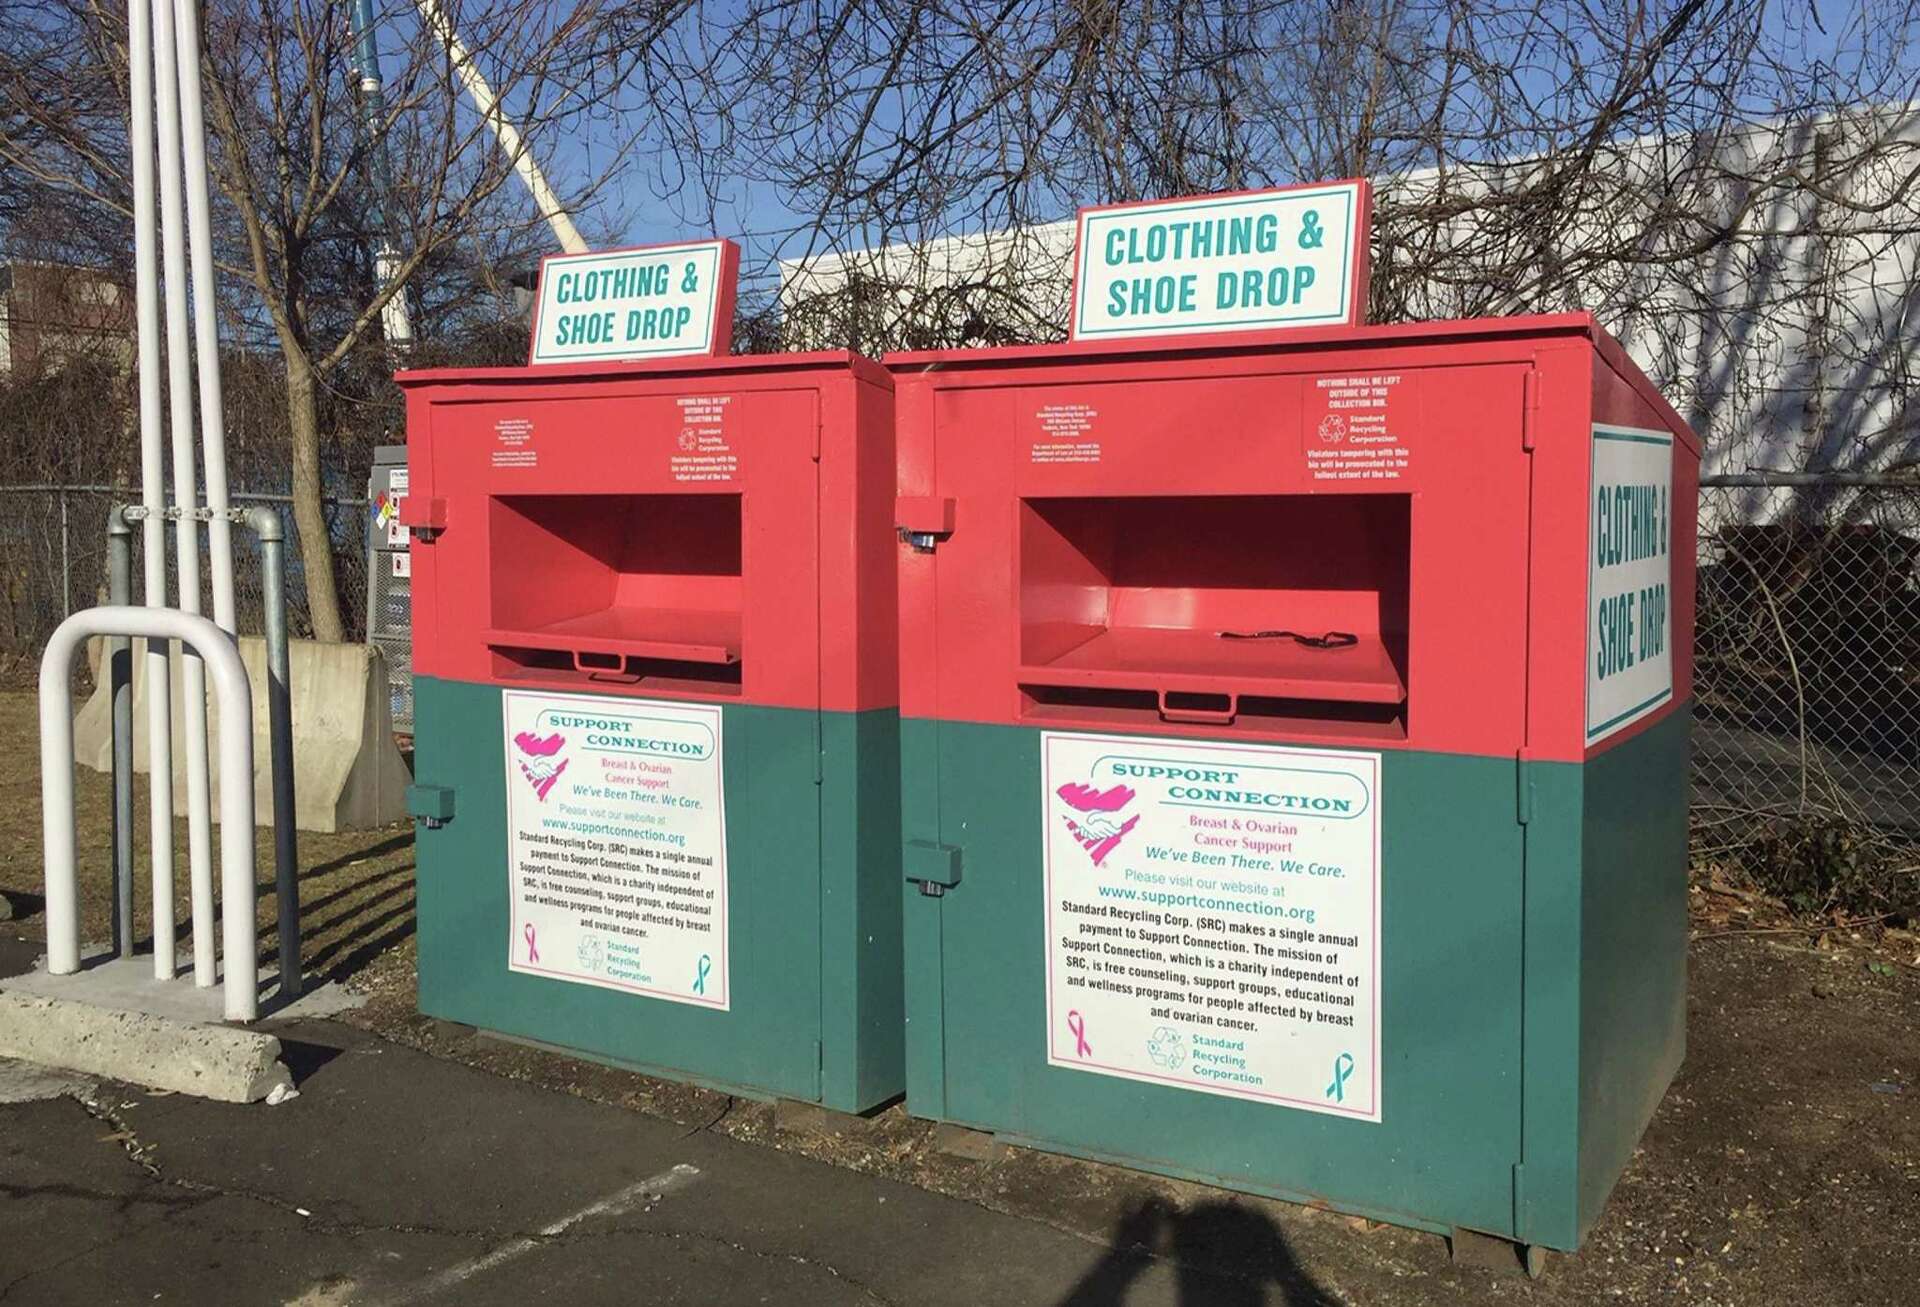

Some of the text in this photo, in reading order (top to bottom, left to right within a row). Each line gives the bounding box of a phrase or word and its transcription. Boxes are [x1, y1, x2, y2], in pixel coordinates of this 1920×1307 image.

[1105, 209, 1324, 266] CLOTHING &
[556, 261, 698, 304] CLOTHING &
[1107, 266, 1315, 317] SHOE DROP
[556, 306, 690, 346] SHOE DROP
[1317, 376, 1401, 387] NOTHING SHALL BE LEFT
[1329, 389, 1358, 398] OUTSIDE
[1372, 388, 1387, 396] THIS
[1350, 415, 1385, 423] Standard
[1350, 426, 1386, 434] Recycling
[1350, 436, 1397, 444] Corporation
[1598, 484, 1666, 569] CLOTHING &
[1598, 584, 1666, 681] SHOE DROP
[550, 715, 632, 732] SUPPORT
[587, 735, 703, 755] CONNECTION
[601, 757, 672, 775] Breast & Ovarian
[1112, 763, 1238, 784] SUPPORT
[604, 772, 669, 790] Cancer Support
[573, 784, 702, 809] We've Been There. We Care.
[1168, 786, 1351, 812] CONNECTION
[542, 818, 685, 847] www.supportconnection.org
[1190, 815, 1297, 836] Breast & Ovarian
[519, 830, 713, 866] Standard Recycling Corp. (SRC) makes a single annual
[1194, 833, 1292, 854] Cancer Support
[530, 850, 701, 881] payment to Support Connection. The mission of
[1146, 846, 1345, 878] We've Been There. We Care.
[520, 861, 547, 874] Support
[547, 865, 590, 881] Connection,
[591, 872, 612, 884] which
[623, 878, 627, 887] a
[629, 878, 655, 893] charity
[657, 883, 704, 898] independent
[706, 890, 714, 899] of
[1125, 868, 1285, 897] Please visit our website at
[523, 877, 539, 889] SRC,
[548, 881, 563, 892] free
[563, 885, 605, 900] counseling,
[607, 892, 634, 903] support
[636, 897, 664, 909] groups,
[666, 900, 711, 915] educational
[1099, 886, 1315, 924] www.supportconnection.org
[524, 894, 711, 932] and wellness programs for people affected by breast
[1062, 900, 1358, 948] Standard Recycling Corp. (SRC) makes a single annual
[580, 919, 648, 938] and ovarian cancer.
[607, 940, 640, 955] Standard
[1079, 923, 1338, 965] payment to Support Connection. The mission of
[1062, 936, 1359, 987] Support Connection, which is a charity independent of
[1066, 955, 1354, 1007] SRC, is free counseling, support groups, educational
[1067, 976, 1353, 1027] and wellness programs for people affected by breast
[1150, 1007, 1258, 1032] and ovarian cancer.
[1193, 1034, 1244, 1051] Standard
[1193, 1049, 1246, 1070] Recycling
[1192, 1064, 1263, 1085] Corporation
